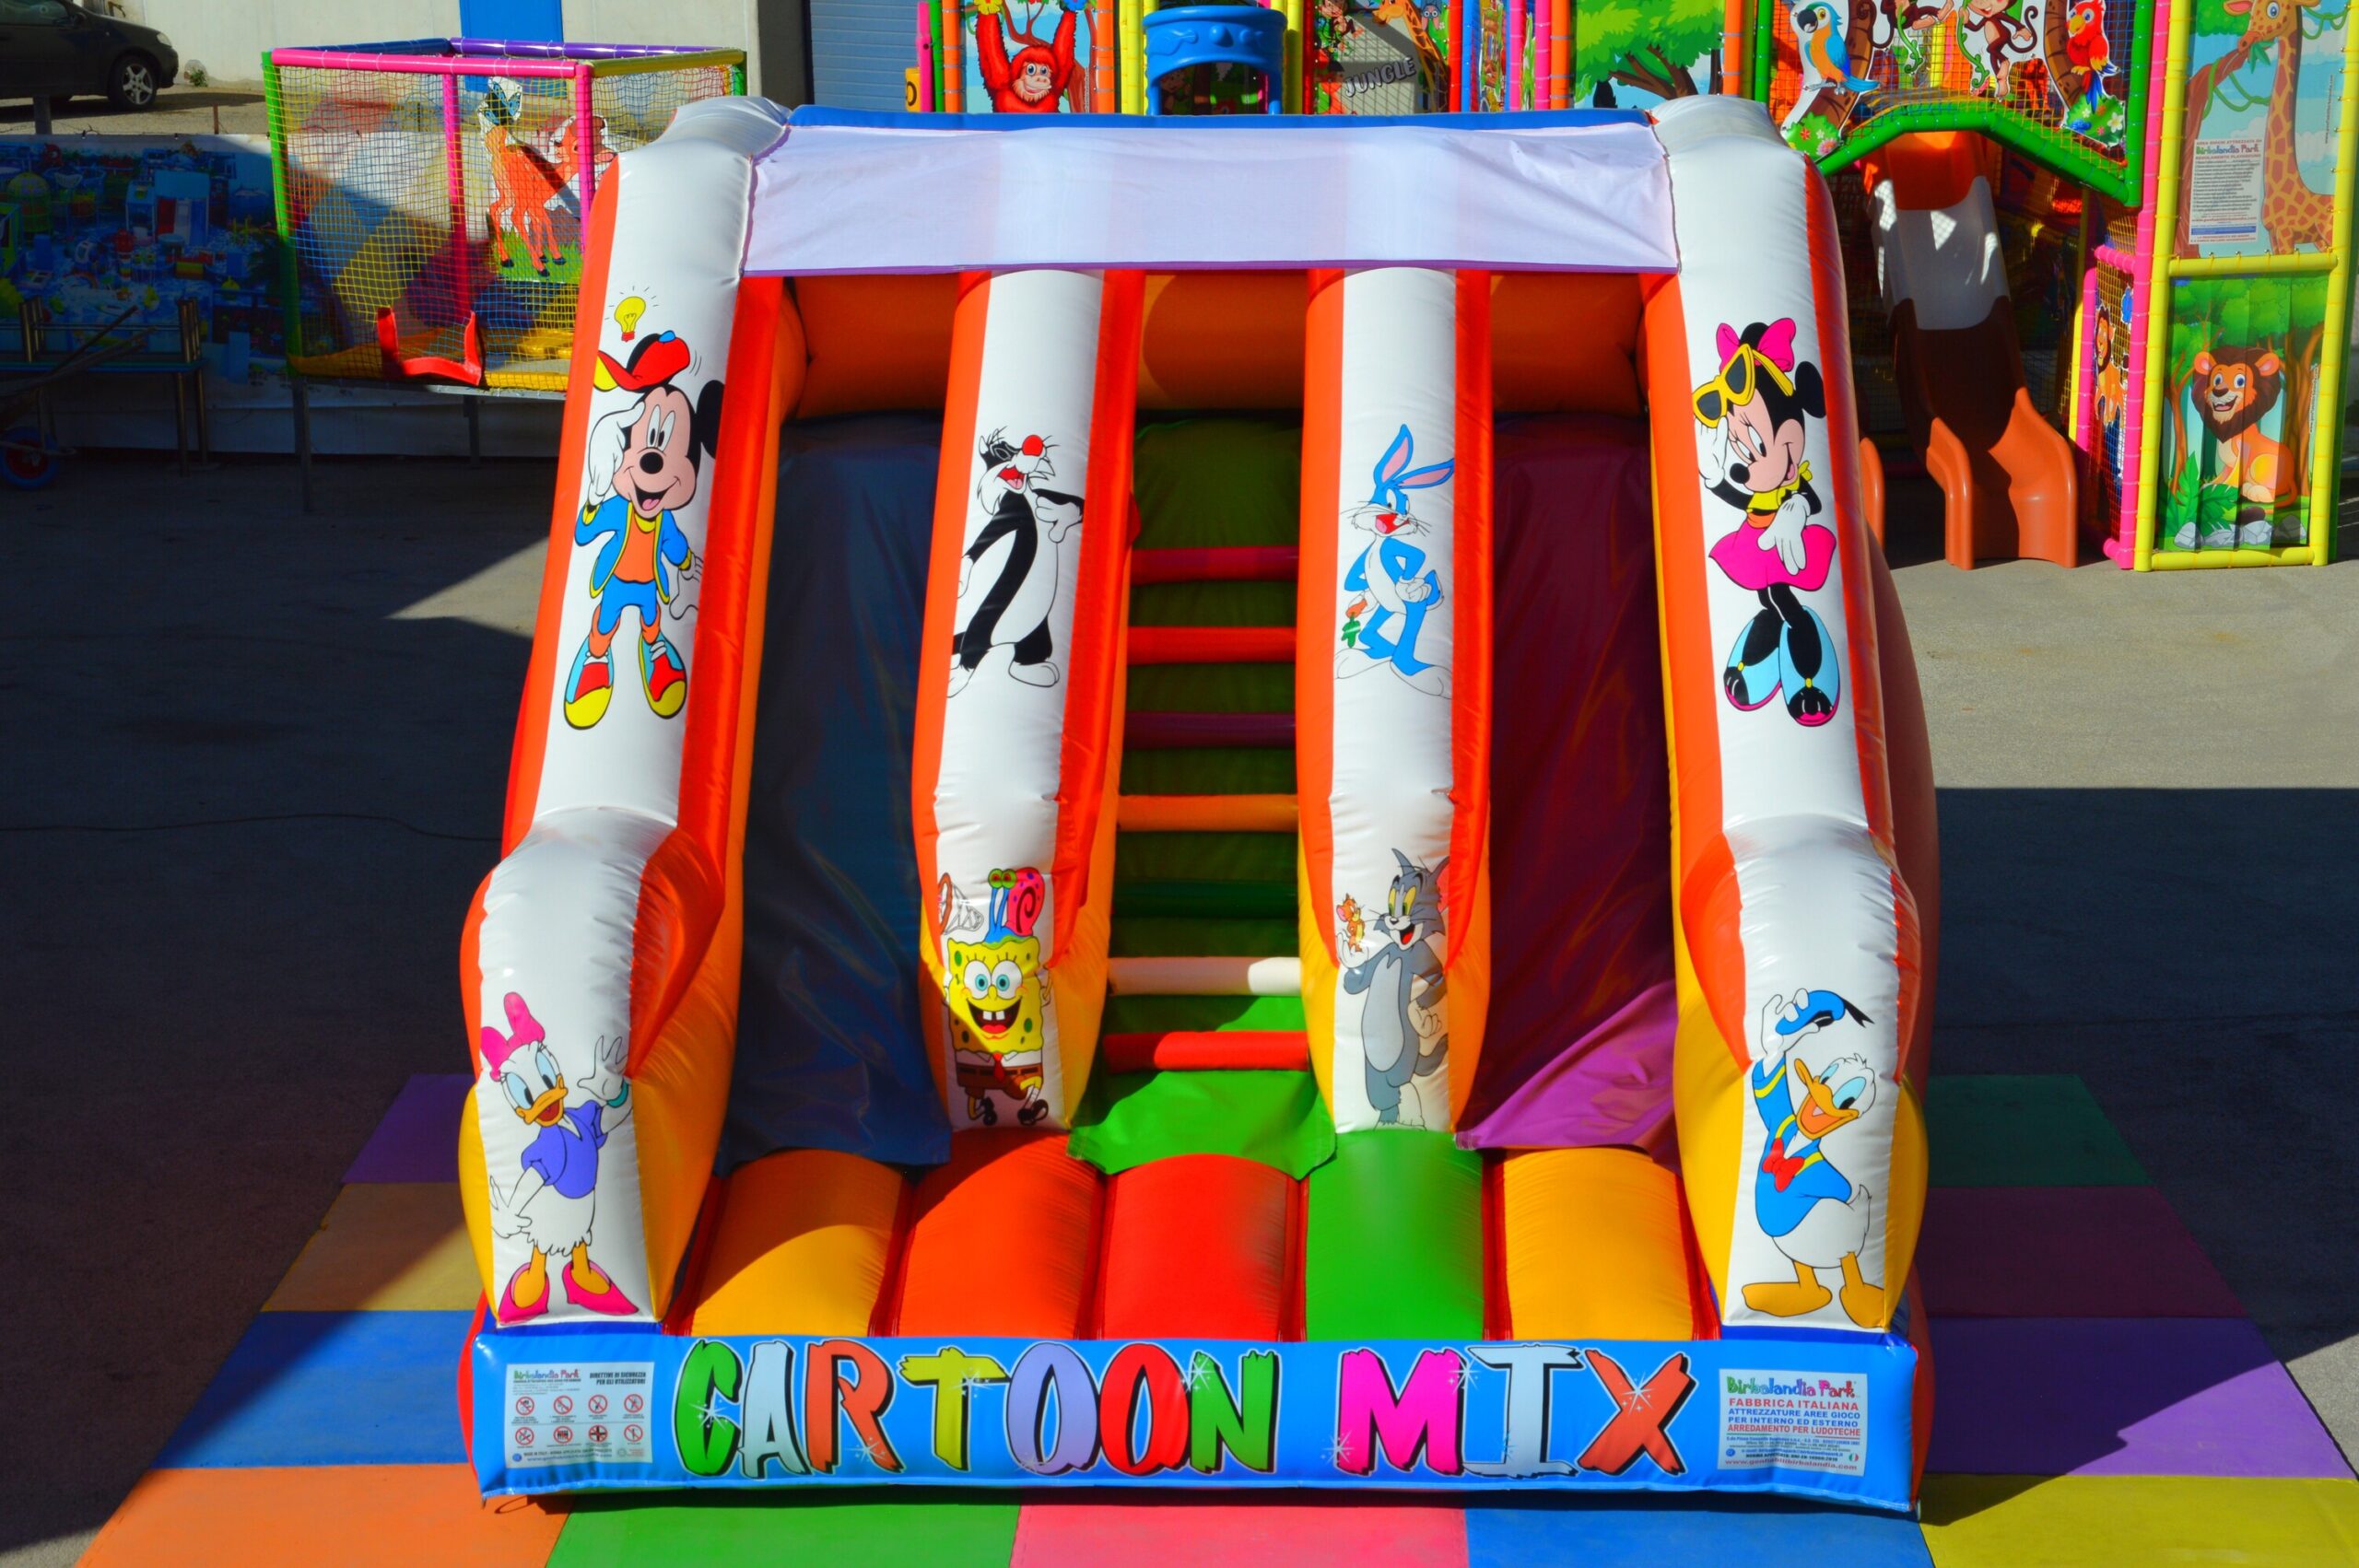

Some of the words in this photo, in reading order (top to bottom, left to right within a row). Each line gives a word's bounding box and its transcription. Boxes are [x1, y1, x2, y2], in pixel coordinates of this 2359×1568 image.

[1345, 56, 1416, 98] JUNGLE
[2241, 143, 2259, 153] Park
[1726, 1375, 1816, 1397] Birbalandia
[1818, 1379, 1856, 1398] Park
[675, 1339, 1281, 1479] CARTOON
[1337, 1343, 1698, 1479] MIX
[1729, 1398, 1794, 1409] FABBRICA
[1798, 1399, 1859, 1410] ITALIANA
[1728, 1408, 1802, 1417] ATTREZZATURE
[1803, 1410, 1828, 1419] AREE
[1831, 1411, 1860, 1420] GIOCO
[1750, 1417, 1794, 1425] INTERNO
[1813, 1419, 1859, 1427] ESTERNO
[1727, 1424, 1790, 1433] ARREDAMENTO
[1811, 1427, 1861, 1436] LUDOTECHE
